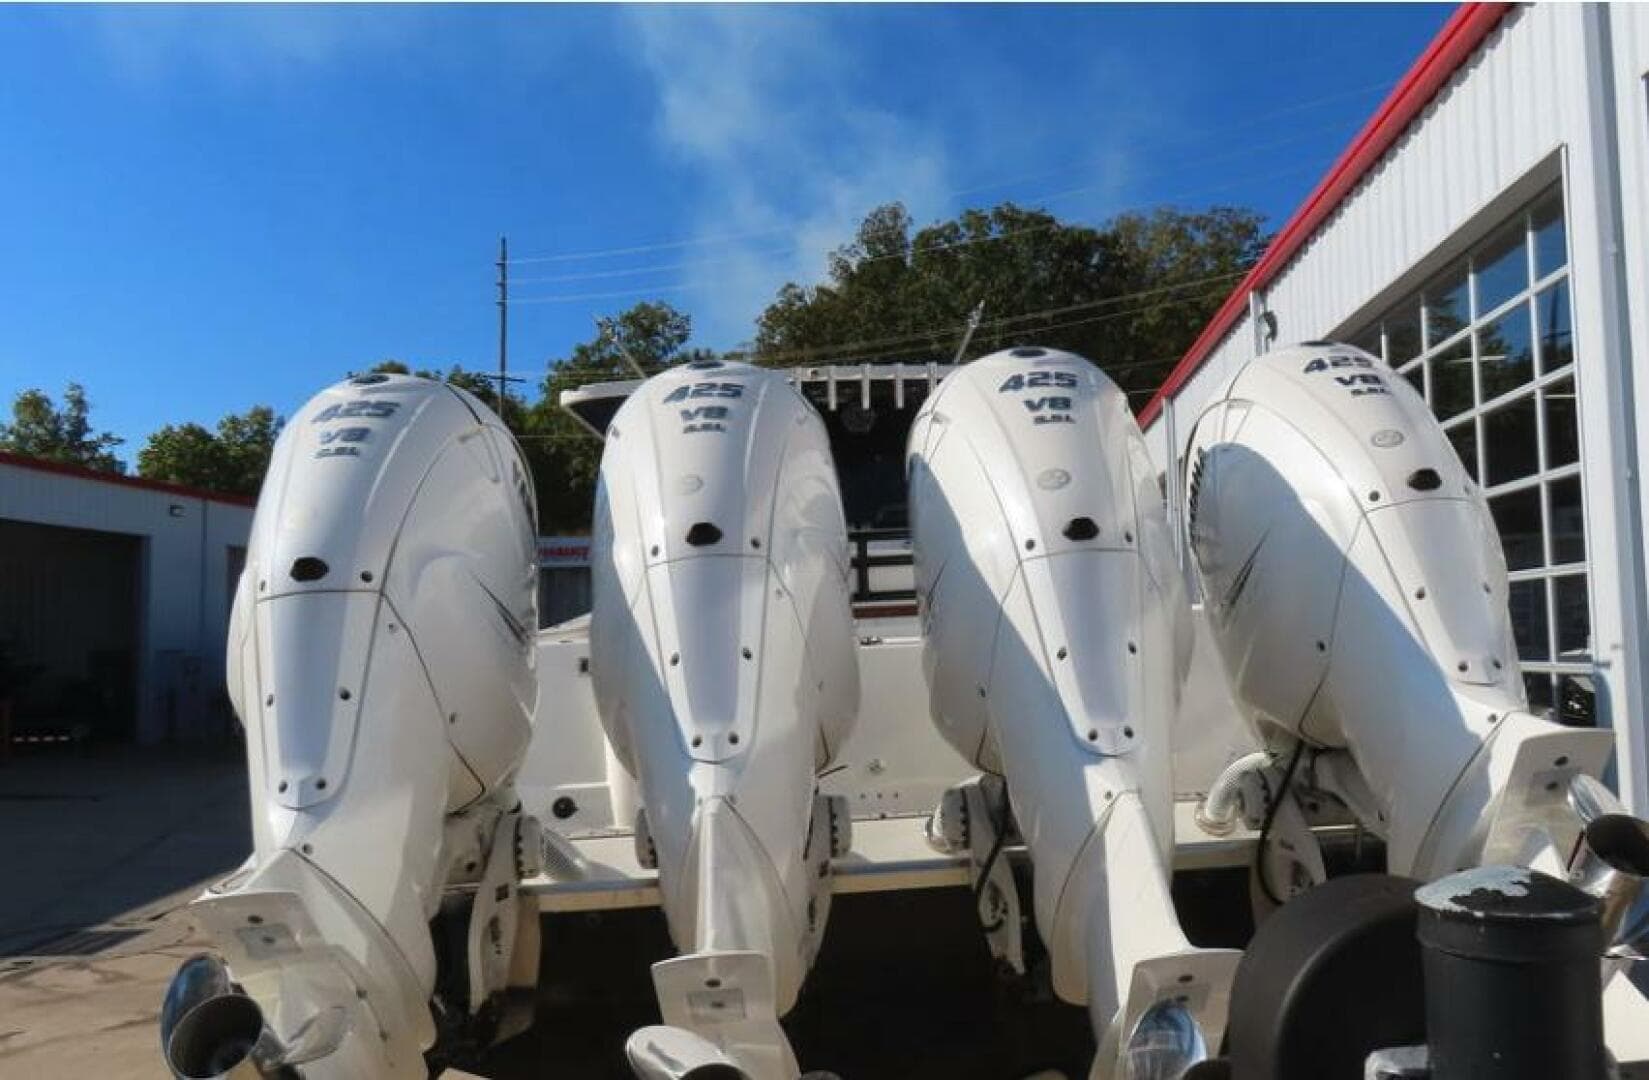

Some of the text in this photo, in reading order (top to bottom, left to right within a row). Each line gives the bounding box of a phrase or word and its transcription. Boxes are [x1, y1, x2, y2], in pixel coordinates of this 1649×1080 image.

[1303, 354, 1373, 374] 425
[999, 370, 1078, 392] 425
[663, 382, 745, 404] 425
[1023, 396, 1072, 411] V8
[311, 400, 401, 423] 425
[680, 405, 728, 420] V8
